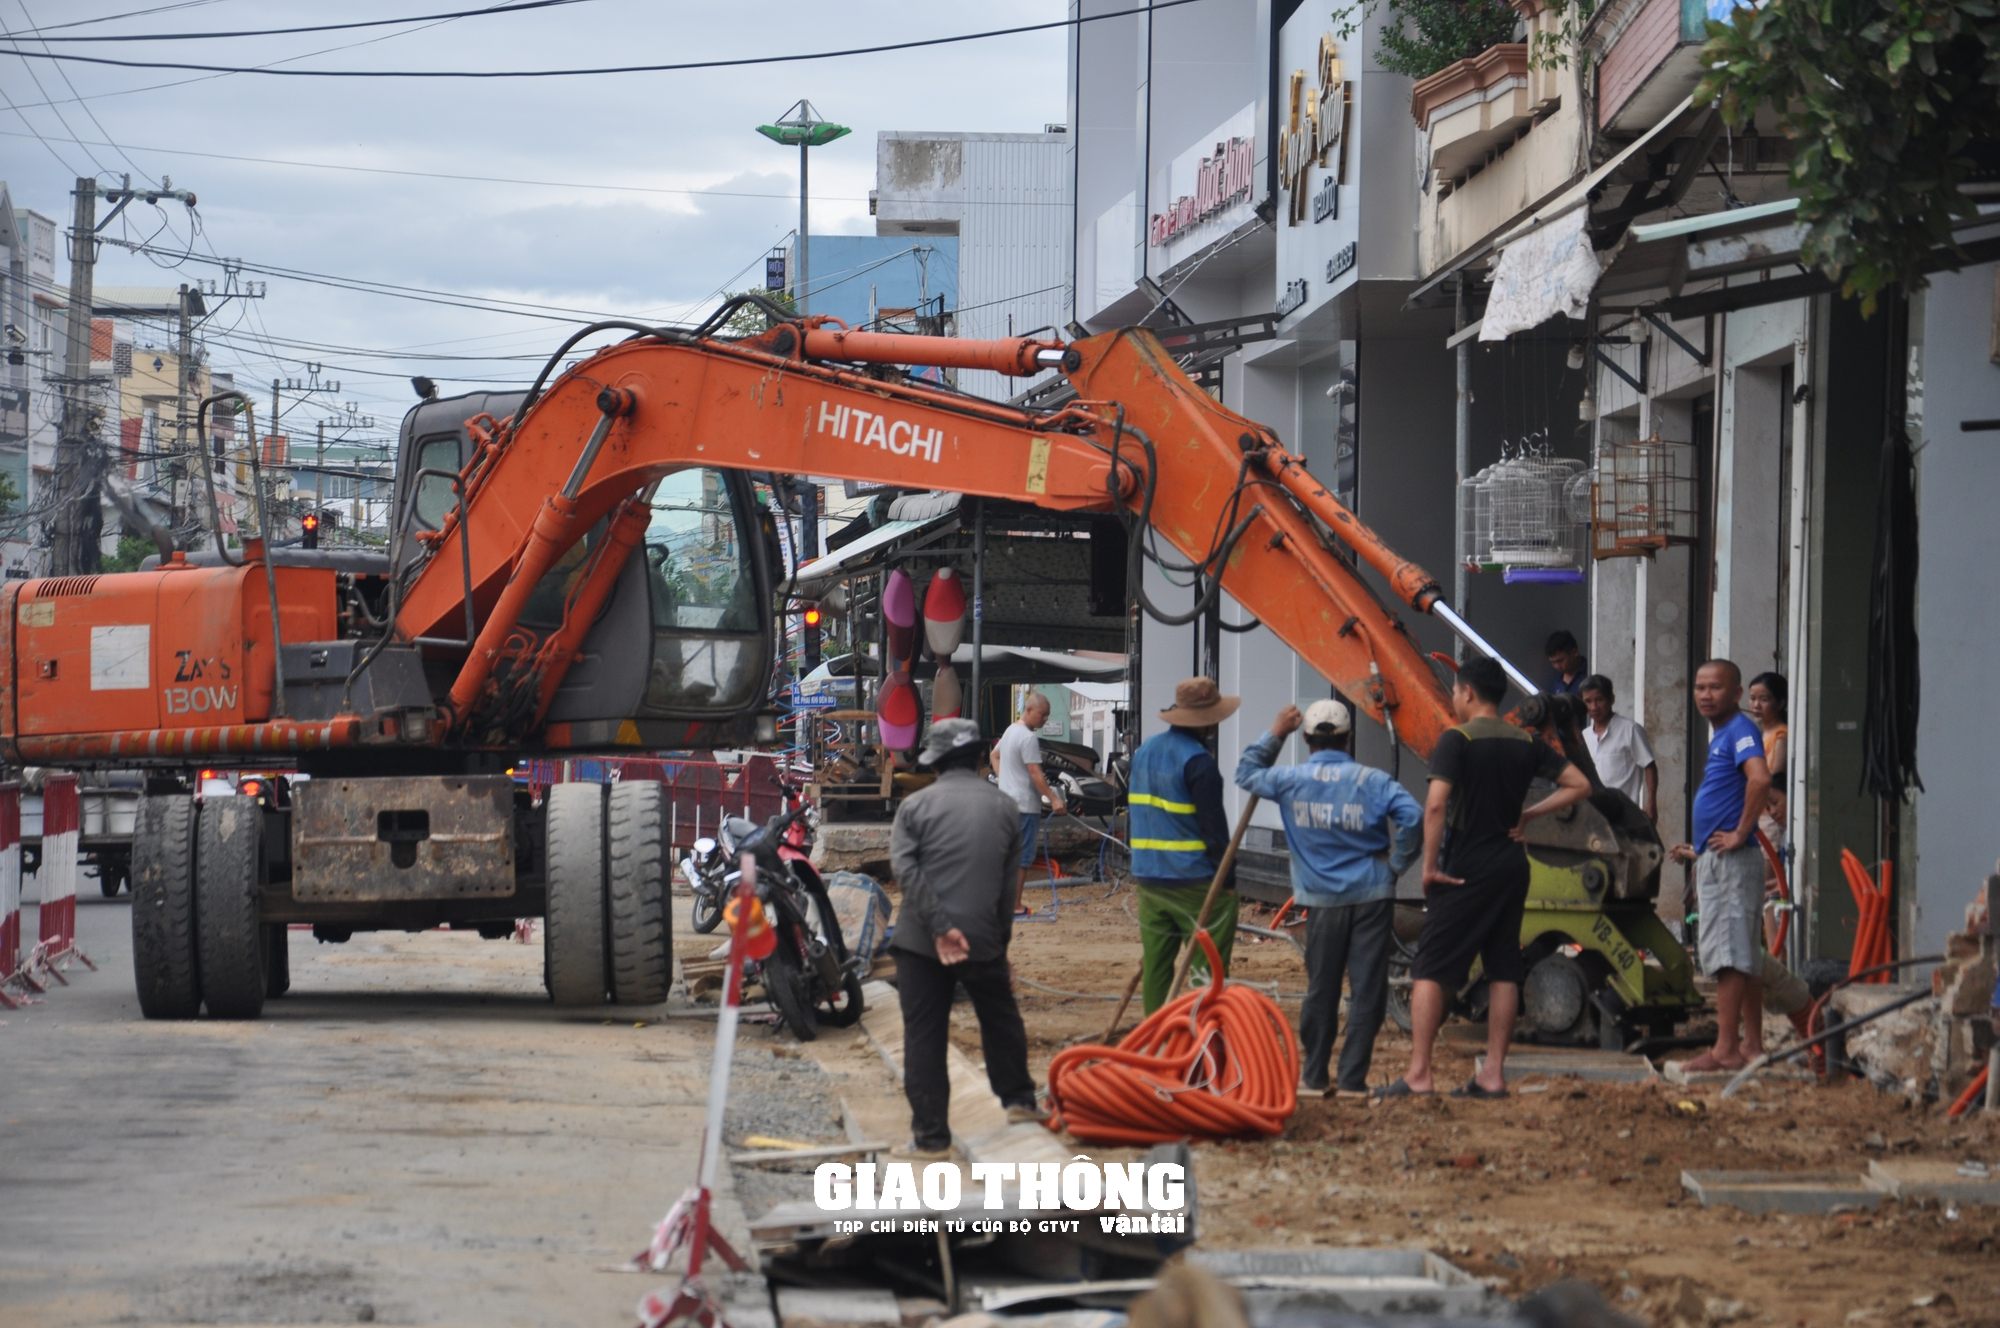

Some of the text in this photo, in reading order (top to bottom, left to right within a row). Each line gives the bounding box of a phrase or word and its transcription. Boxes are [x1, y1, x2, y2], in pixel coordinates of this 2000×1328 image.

[817, 401, 944, 464] HITACHI
[164, 684, 239, 715] 130W
[1342, 803, 1364, 832] CVC
[1592, 915, 1635, 971] VB-140
